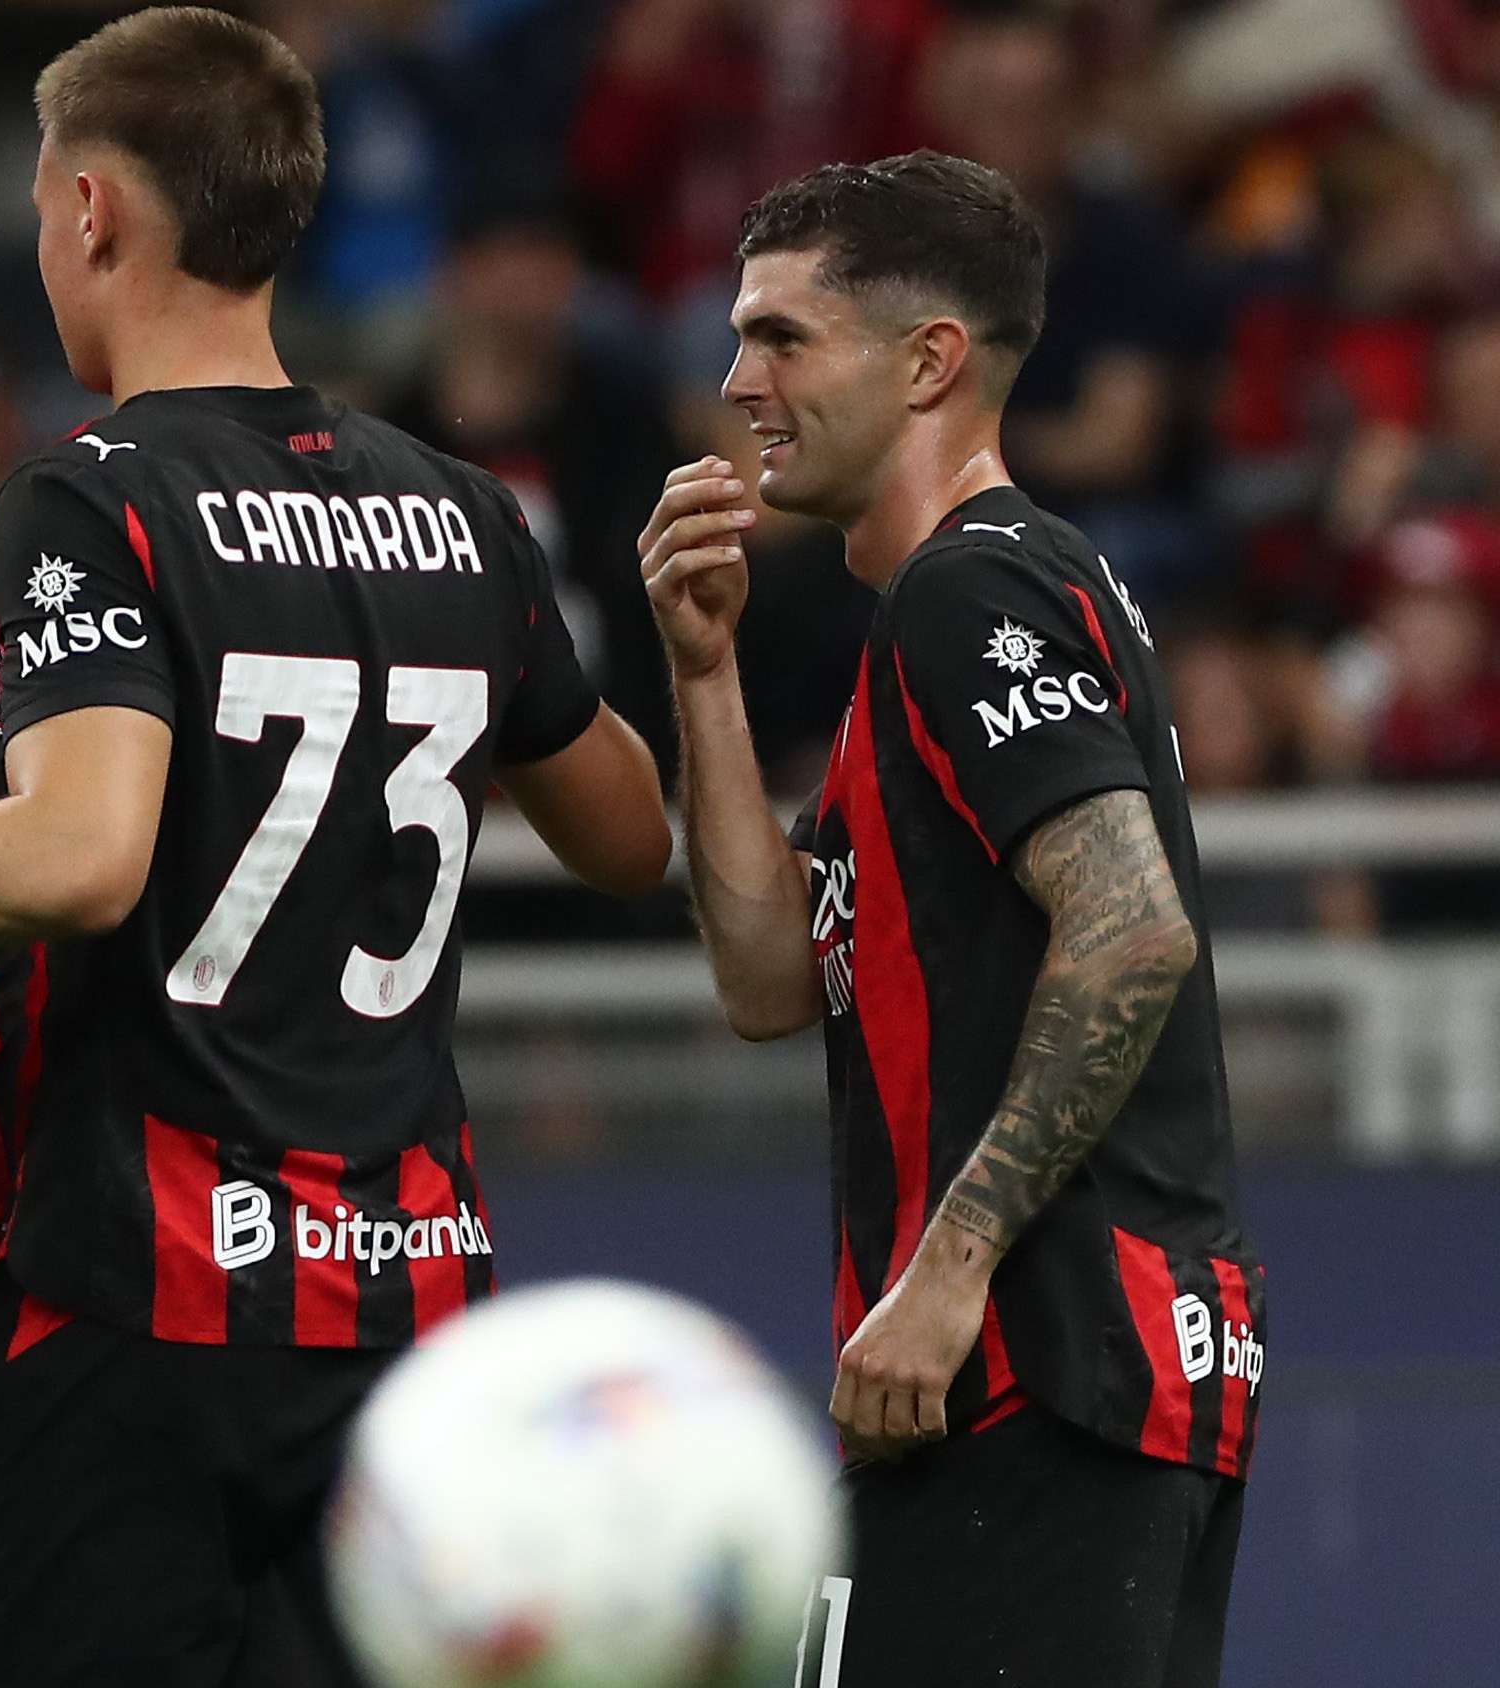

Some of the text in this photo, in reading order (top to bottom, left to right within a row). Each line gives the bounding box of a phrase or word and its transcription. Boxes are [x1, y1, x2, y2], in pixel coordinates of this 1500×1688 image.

[196, 490, 483, 574] CAMARDA
[16, 606, 148, 679] MSC
[971, 671, 1110, 749] MSC
[165, 652, 489, 1018] 73
[295, 1201, 494, 1277] bitpanda
